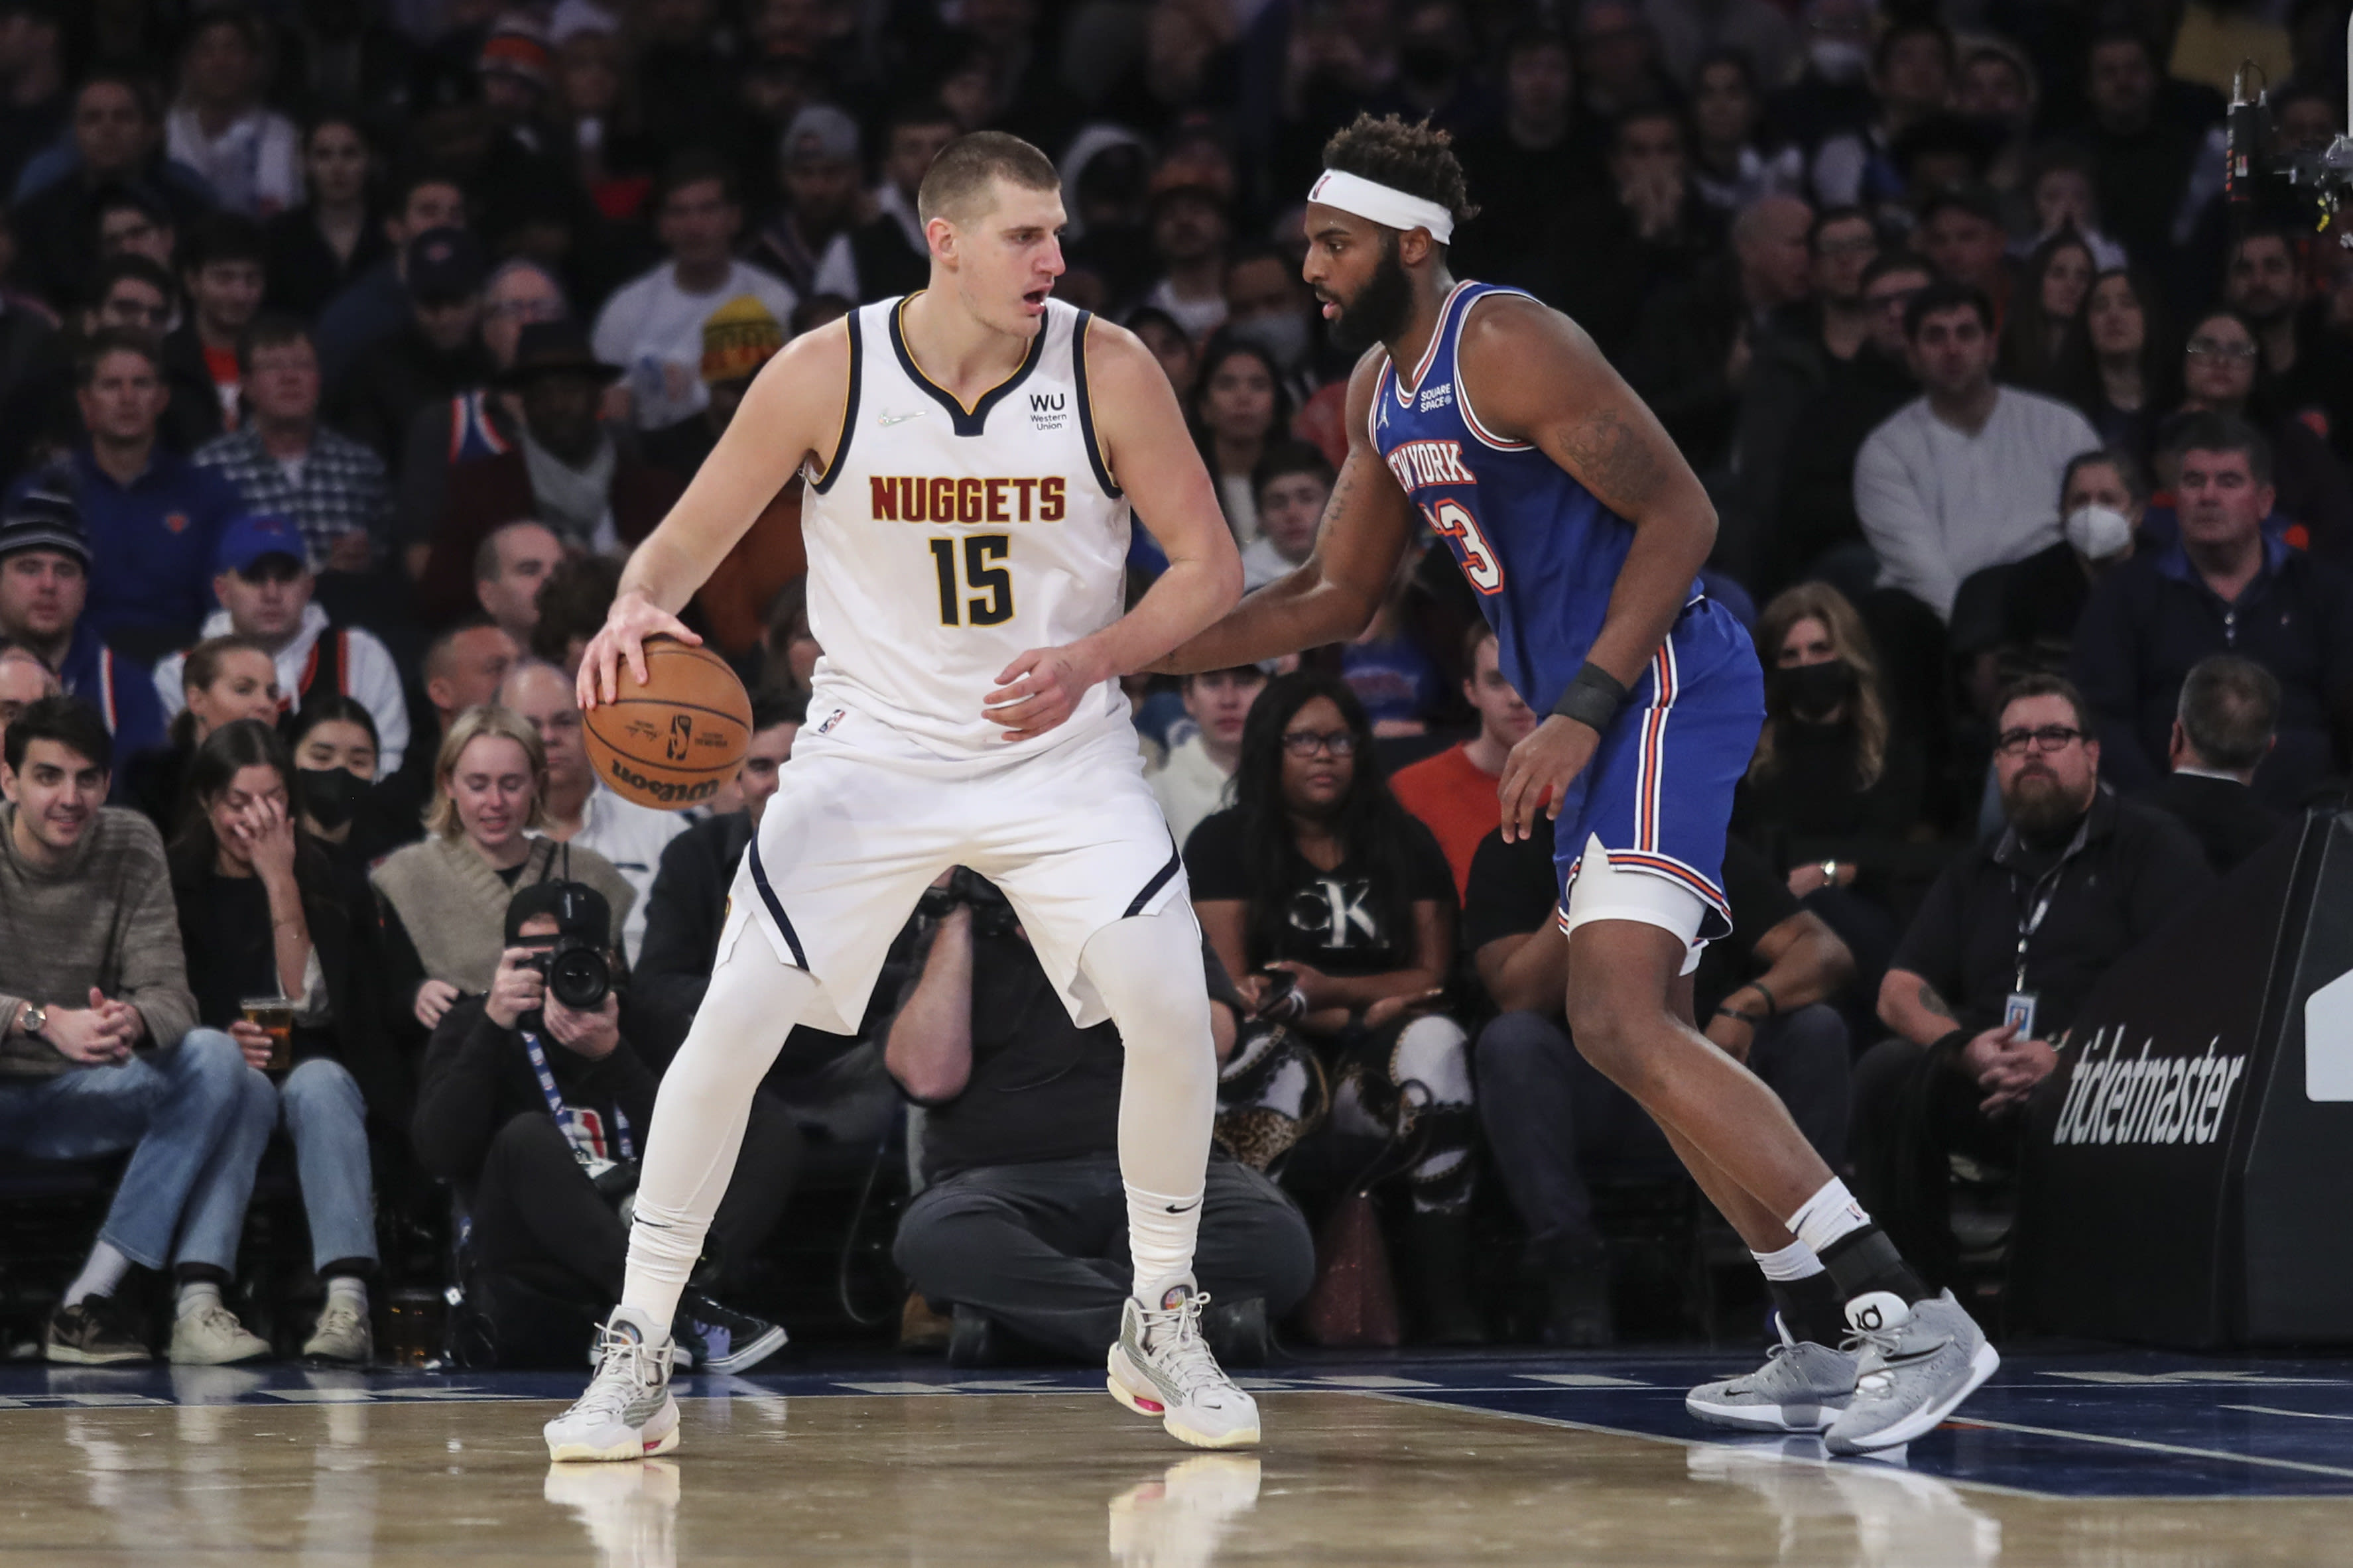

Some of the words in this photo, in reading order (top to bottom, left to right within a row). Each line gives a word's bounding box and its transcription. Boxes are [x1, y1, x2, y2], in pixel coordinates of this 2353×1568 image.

[1421, 383, 1451, 402] SQUARE
[1029, 393, 1065, 412] WU
[1420, 396, 1444, 413] SPACE
[1031, 414, 1067, 423] Western
[1037, 422, 1063, 431] Union
[1406, 440, 1478, 487] YORK
[869, 475, 1066, 524] NUGGETS
[928, 533, 1015, 629] 15
[2053, 1023, 2246, 1146] ticketmaster
